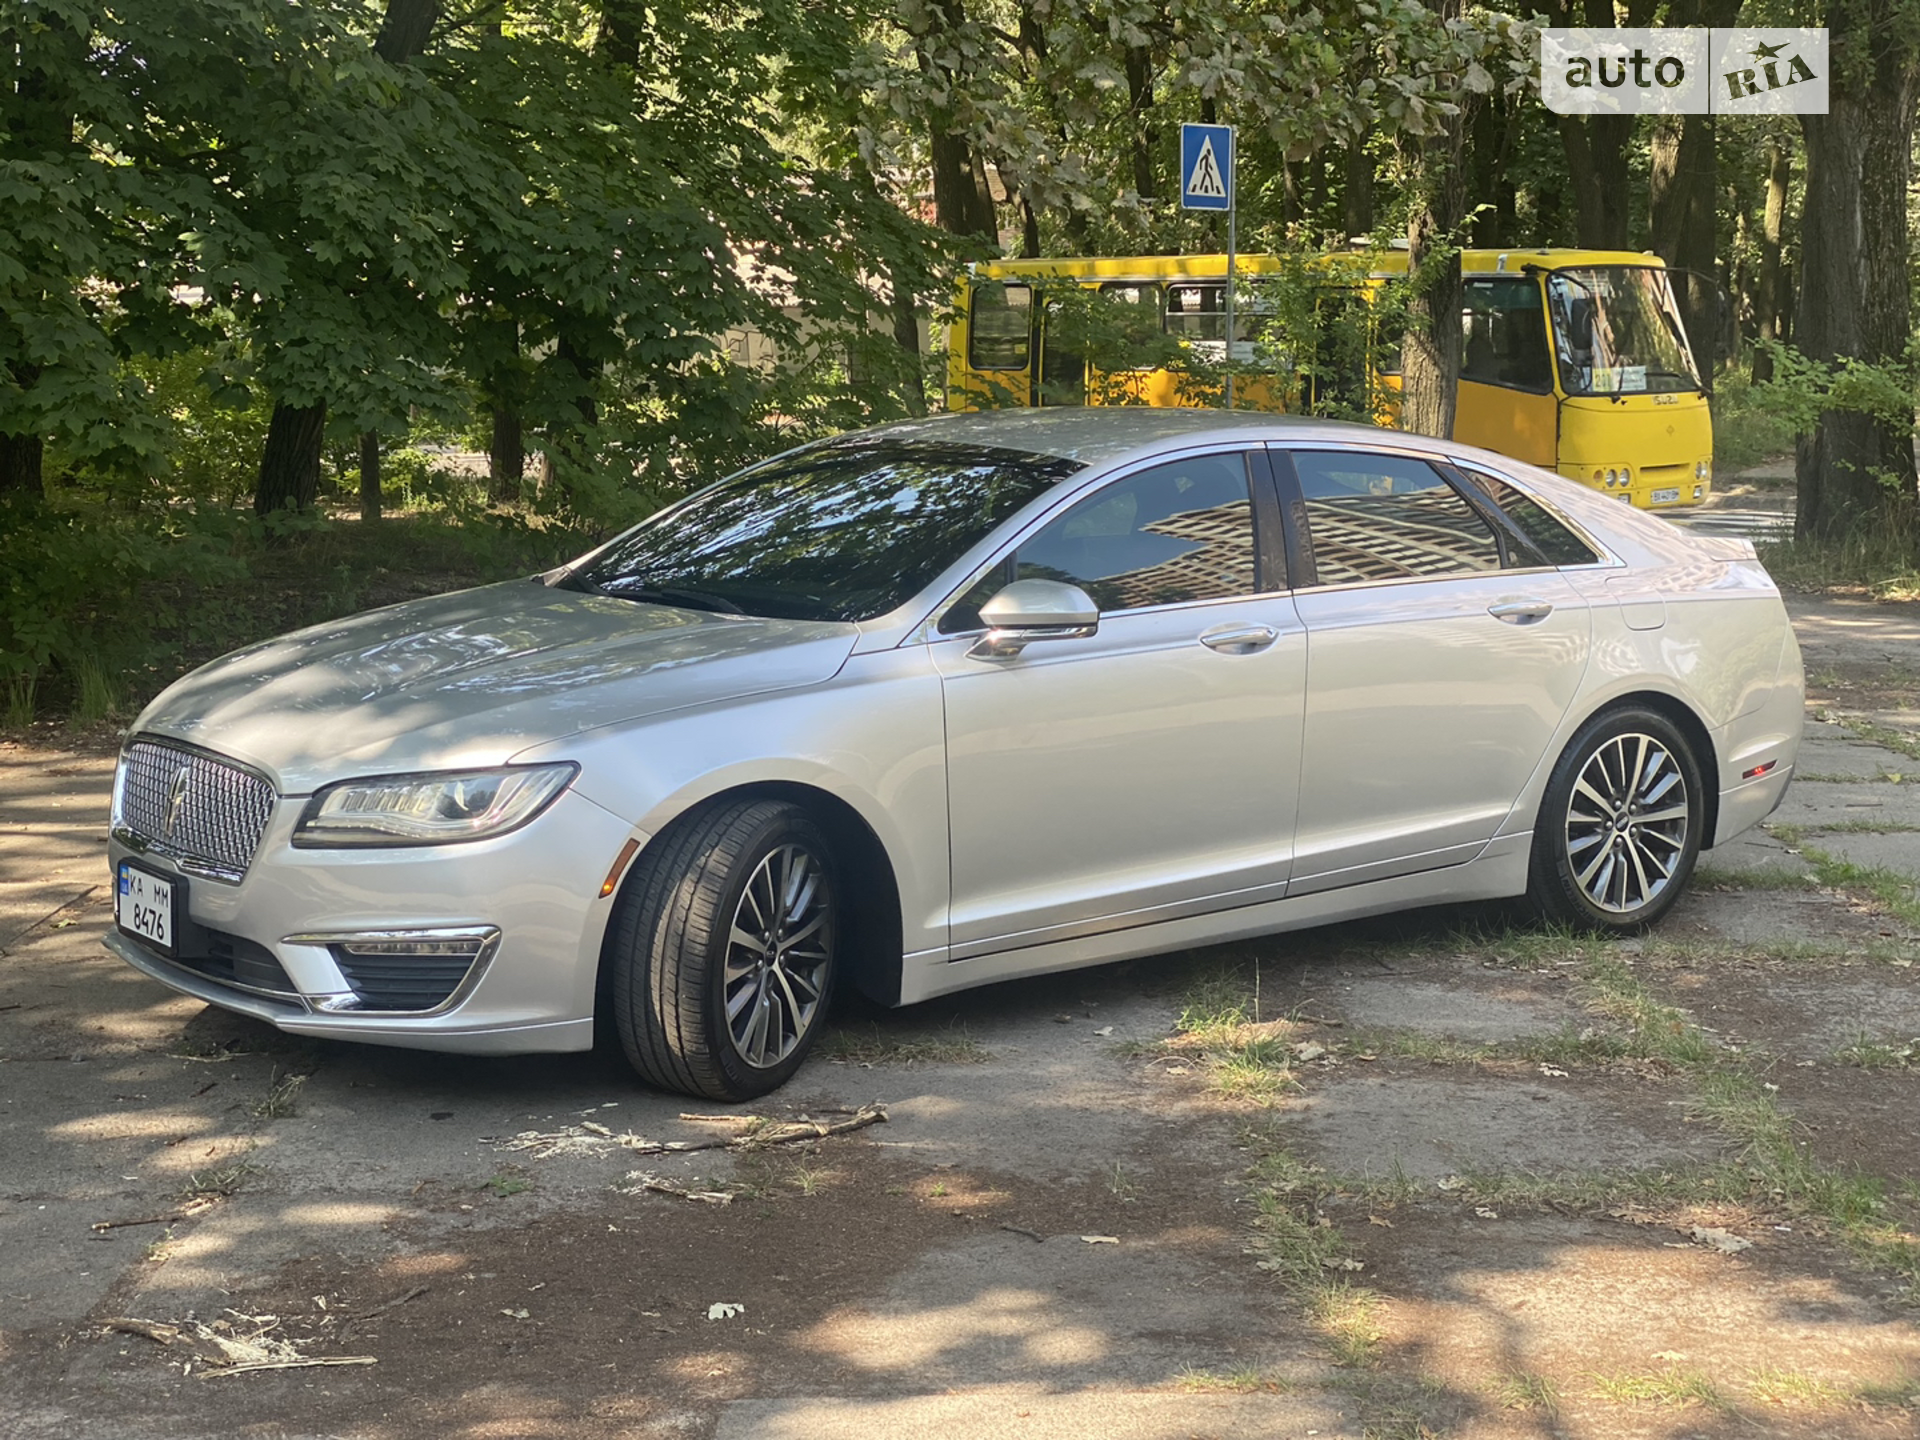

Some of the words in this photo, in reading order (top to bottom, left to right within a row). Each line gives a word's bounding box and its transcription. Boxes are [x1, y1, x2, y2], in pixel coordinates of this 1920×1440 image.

[130, 874, 143, 897] KA
[154, 884, 169, 908] MM
[134, 902, 165, 940] 8476
